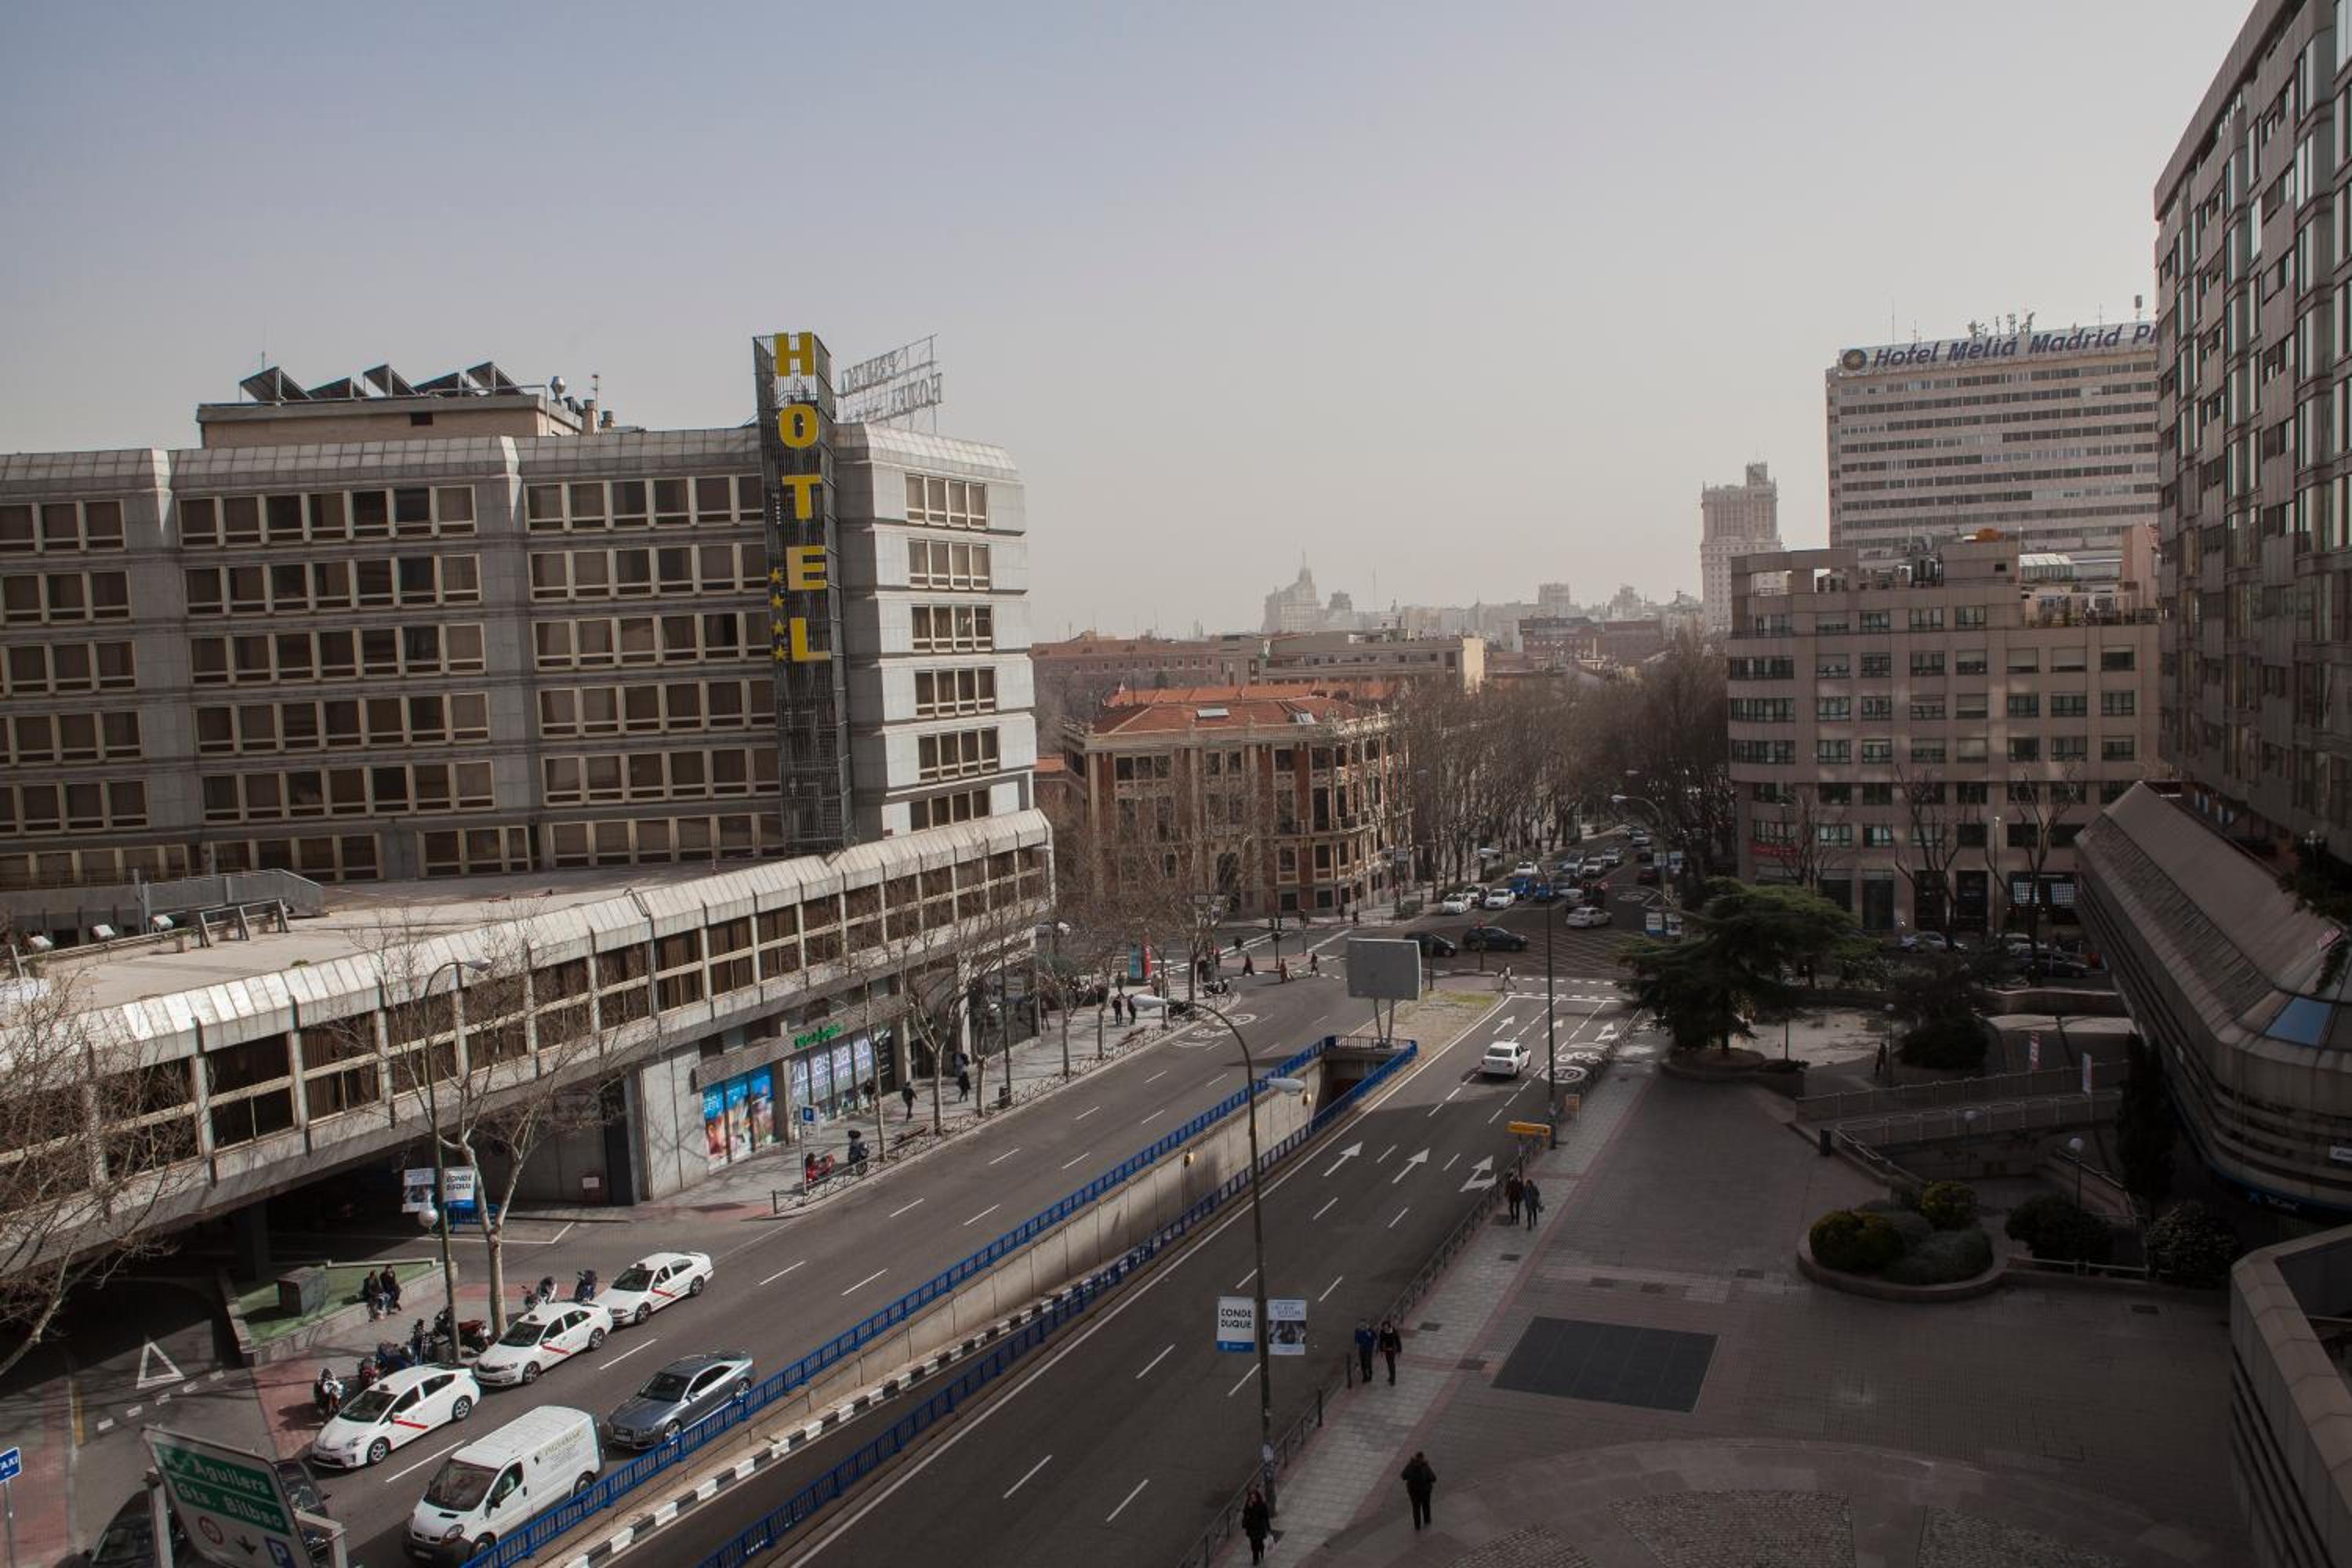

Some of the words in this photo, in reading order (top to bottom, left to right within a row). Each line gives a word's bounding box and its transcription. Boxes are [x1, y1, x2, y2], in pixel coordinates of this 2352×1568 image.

[1874, 342, 1939, 367] Hotel
[1947, 336, 2017, 361] Meliá
[2028, 324, 2123, 354] Madrid
[774, 332, 832, 662] HOTEL
[1221, 1308, 1252, 1318] CONDE
[1221, 1319, 1252, 1329] DUQUE
[0, 1455, 18, 1471] AXI
[194, 1460, 270, 1494] Aguilera
[223, 1496, 283, 1529] Bilbao
